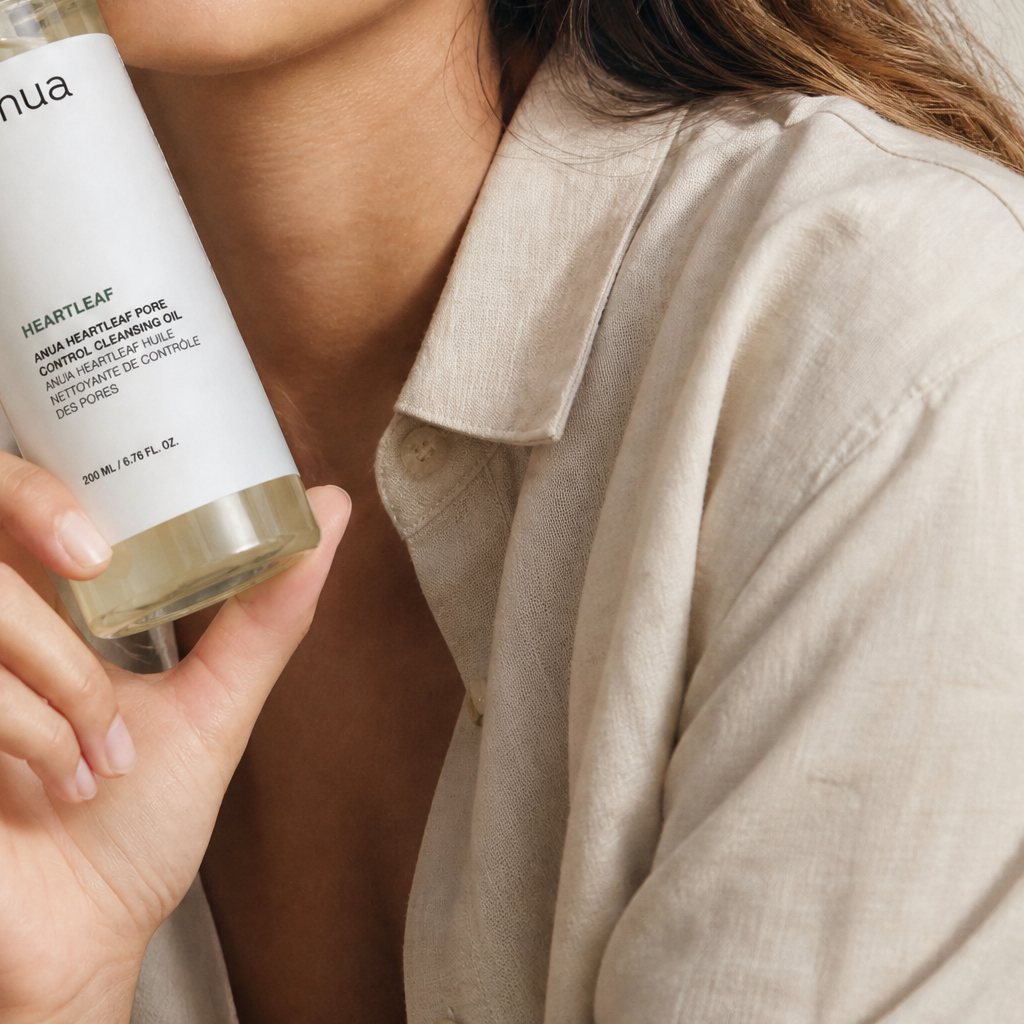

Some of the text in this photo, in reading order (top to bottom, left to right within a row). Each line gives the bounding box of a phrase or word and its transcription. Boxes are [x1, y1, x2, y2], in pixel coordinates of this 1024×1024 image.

[21, 287, 114, 339] HEARTLEAF
[34, 299, 168, 363] ANUA HEARTLEAF PORE
[39, 310, 183, 377] CONTROL CLEANSING OIL
[75, 342, 140, 377] HEARTLEAF
[142, 328, 175, 349] HUILE
[50, 366, 121, 406] NETTOYANTE
[122, 358, 140, 373] DE
[55, 383, 120, 419] DES PORES
[82, 437, 180, 486] 200 ML / 6.76 FL. OZ.
